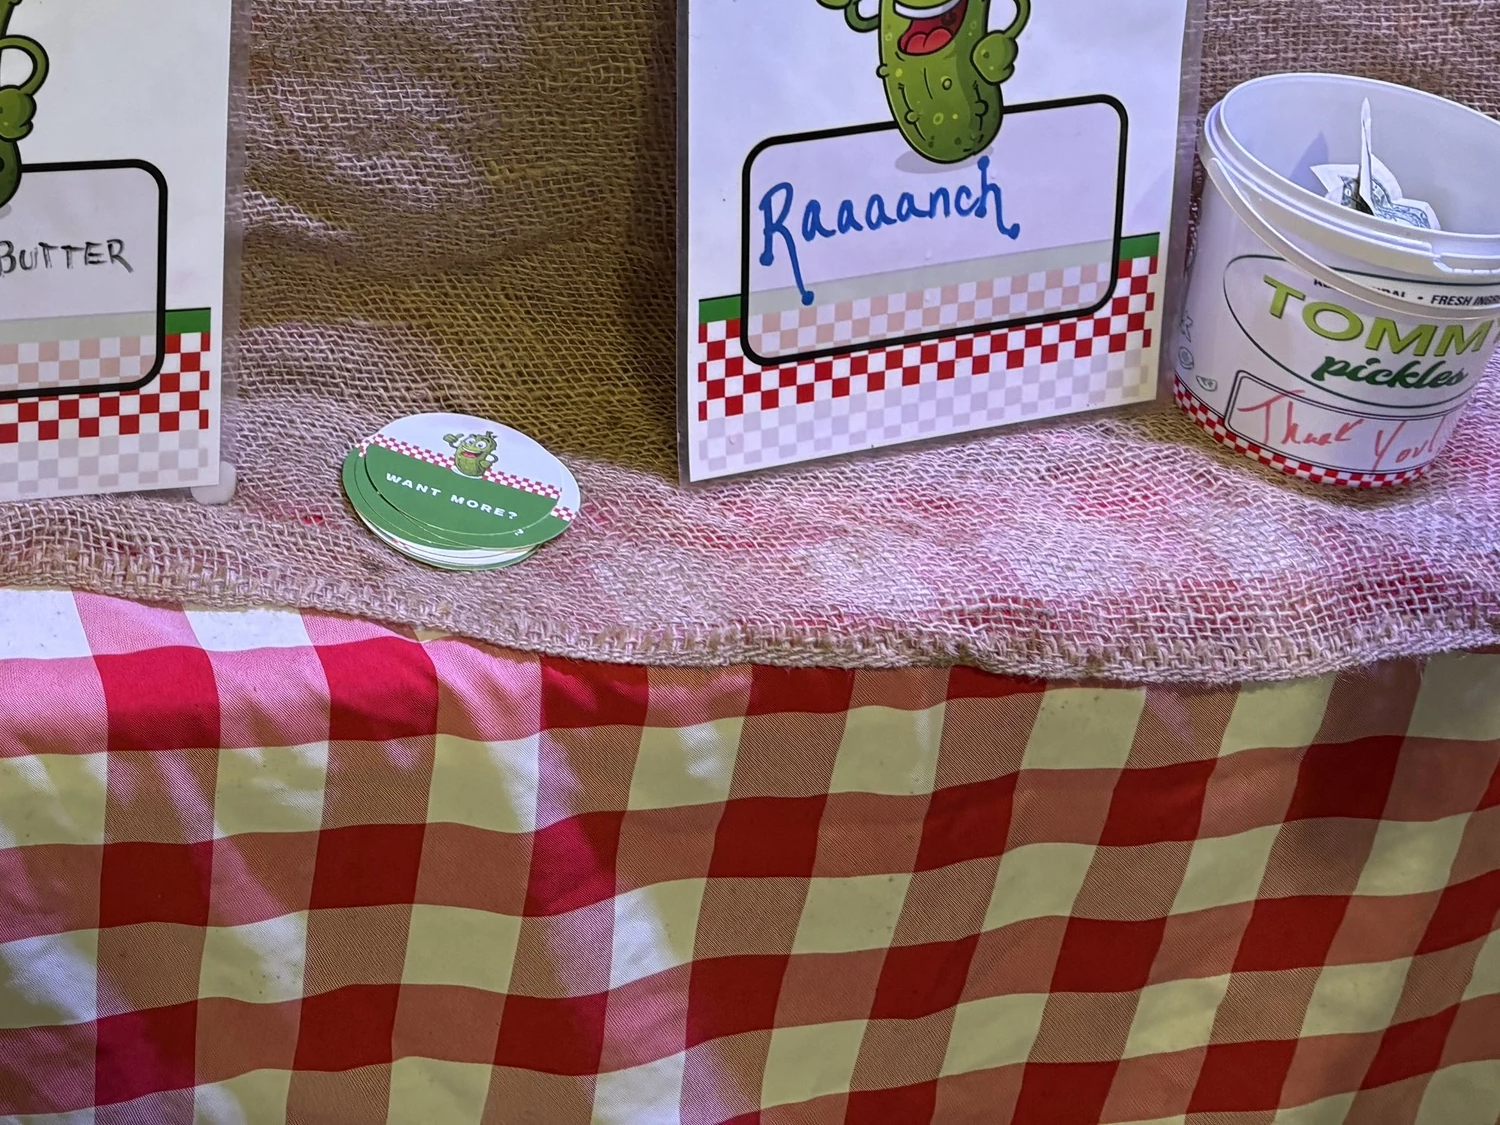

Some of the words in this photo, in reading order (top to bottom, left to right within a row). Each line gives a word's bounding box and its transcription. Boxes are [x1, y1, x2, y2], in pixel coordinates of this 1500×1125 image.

[758, 155, 1021, 306] Raaaanch
[1263, 274, 1500, 358] TOMM
[1430, 294, 1473, 306] FRESH
[1310, 355, 1469, 390] pickles
[386, 472, 442, 497] WANT
[450, 493, 518, 521] MORE?
